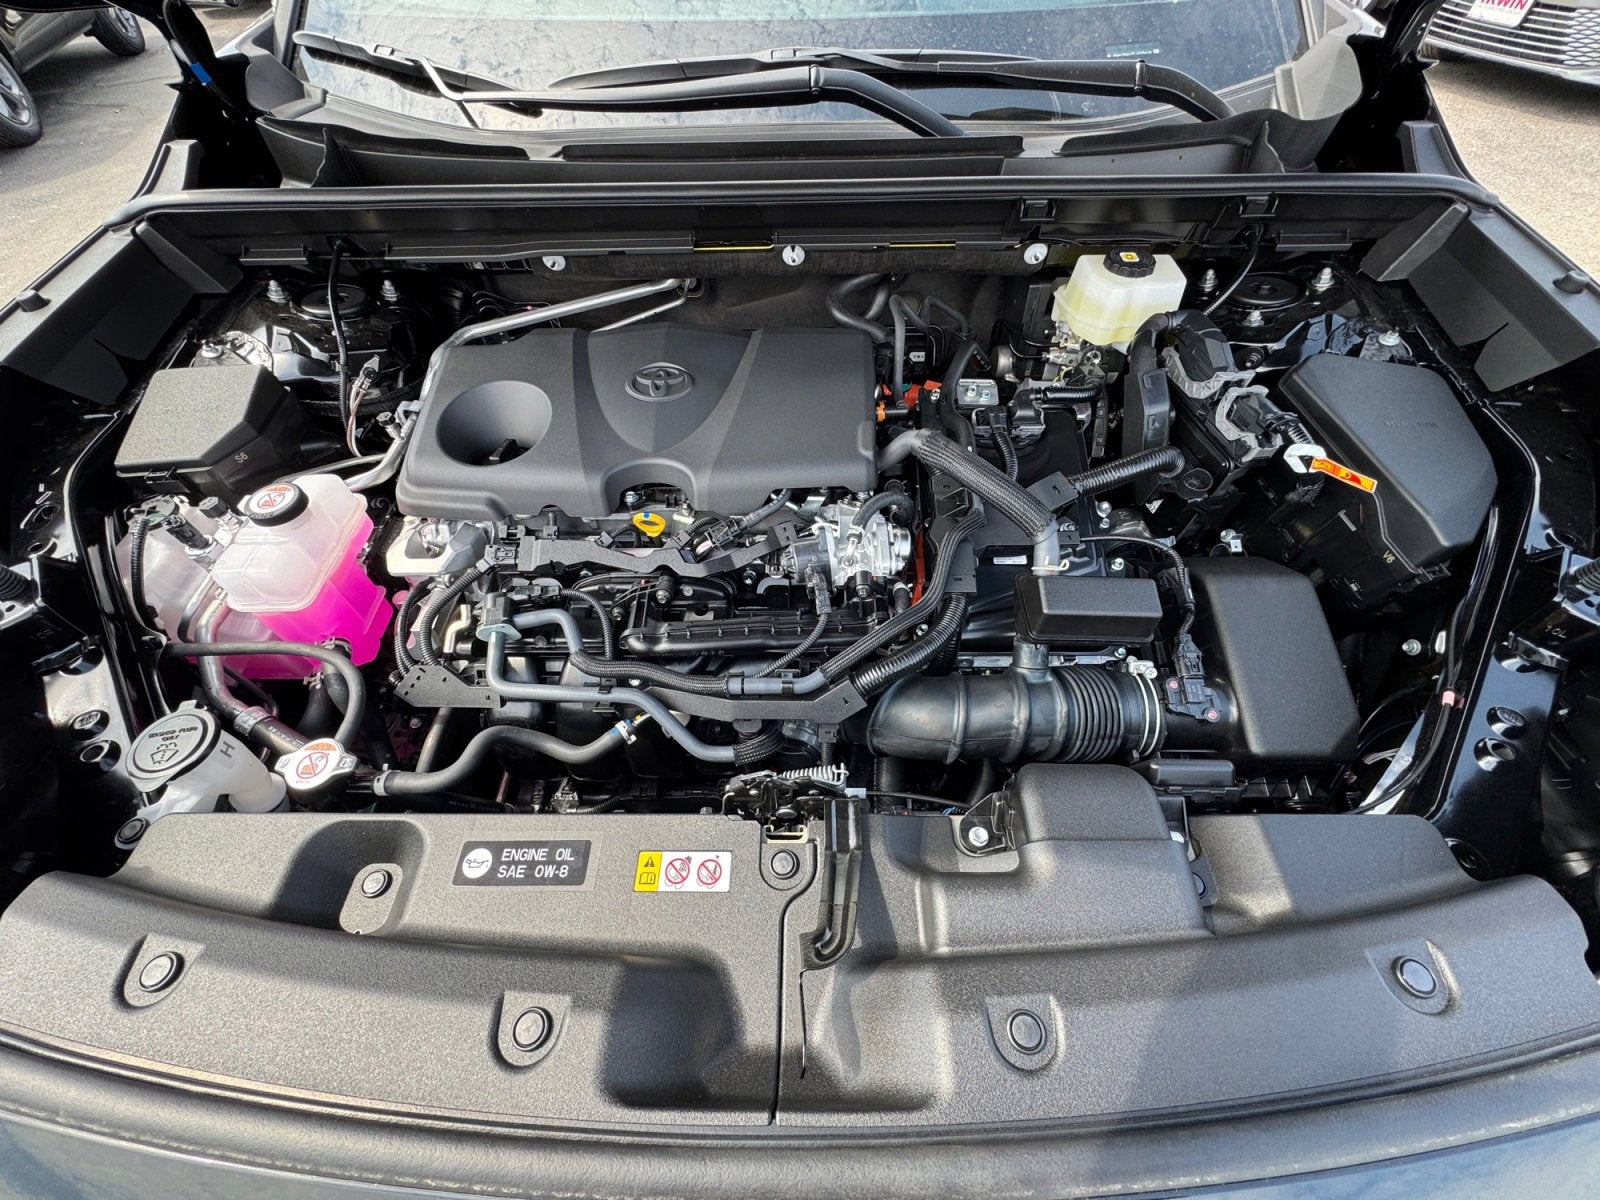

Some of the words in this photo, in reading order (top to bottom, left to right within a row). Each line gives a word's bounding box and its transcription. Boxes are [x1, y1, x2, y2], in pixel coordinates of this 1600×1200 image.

[1480, 0, 1529, 10] WIN
[501, 848, 549, 861] ENGINE
[555, 848, 575, 861] OIL
[497, 865, 527, 878] SAE
[534, 865, 569, 878] 0W-8
